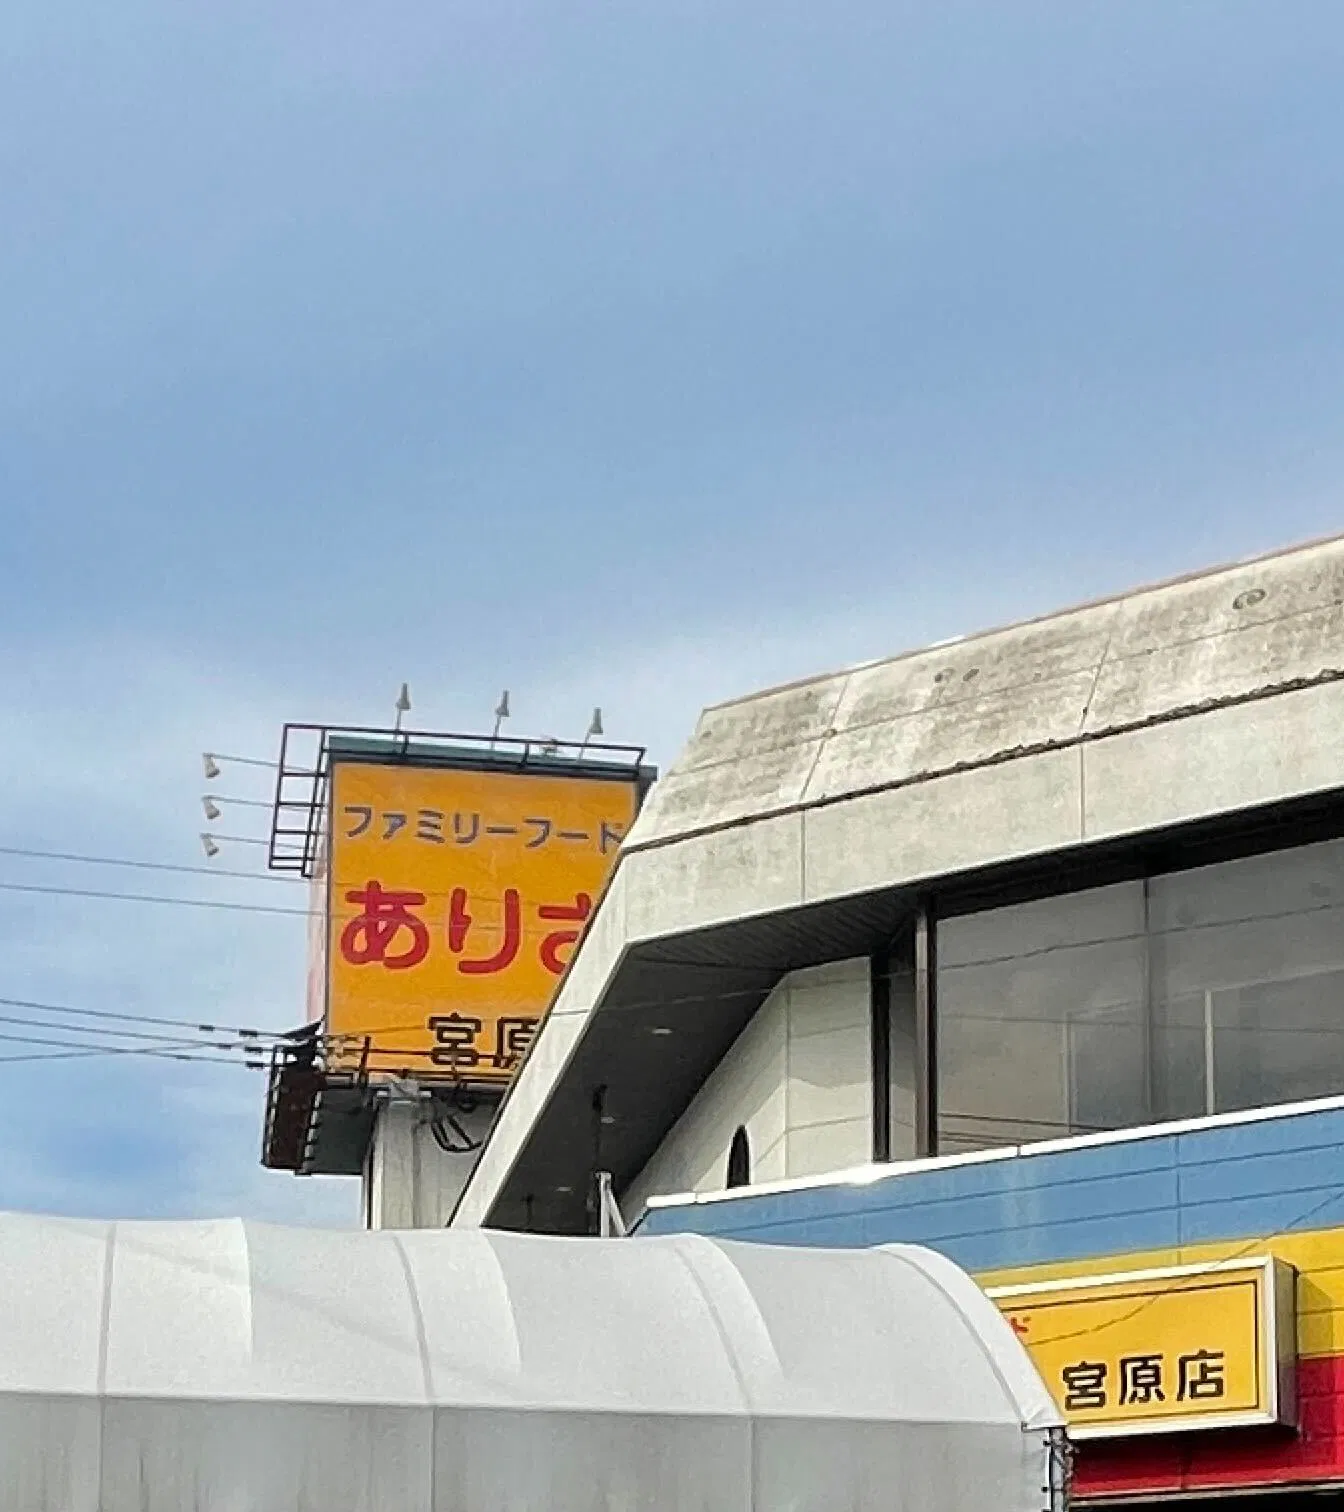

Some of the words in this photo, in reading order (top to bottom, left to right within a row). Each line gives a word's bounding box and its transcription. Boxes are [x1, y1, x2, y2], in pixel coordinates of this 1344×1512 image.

[344, 805, 624, 855] ファミリーフード
[1061, 1348, 1225, 1412] 宮原店
